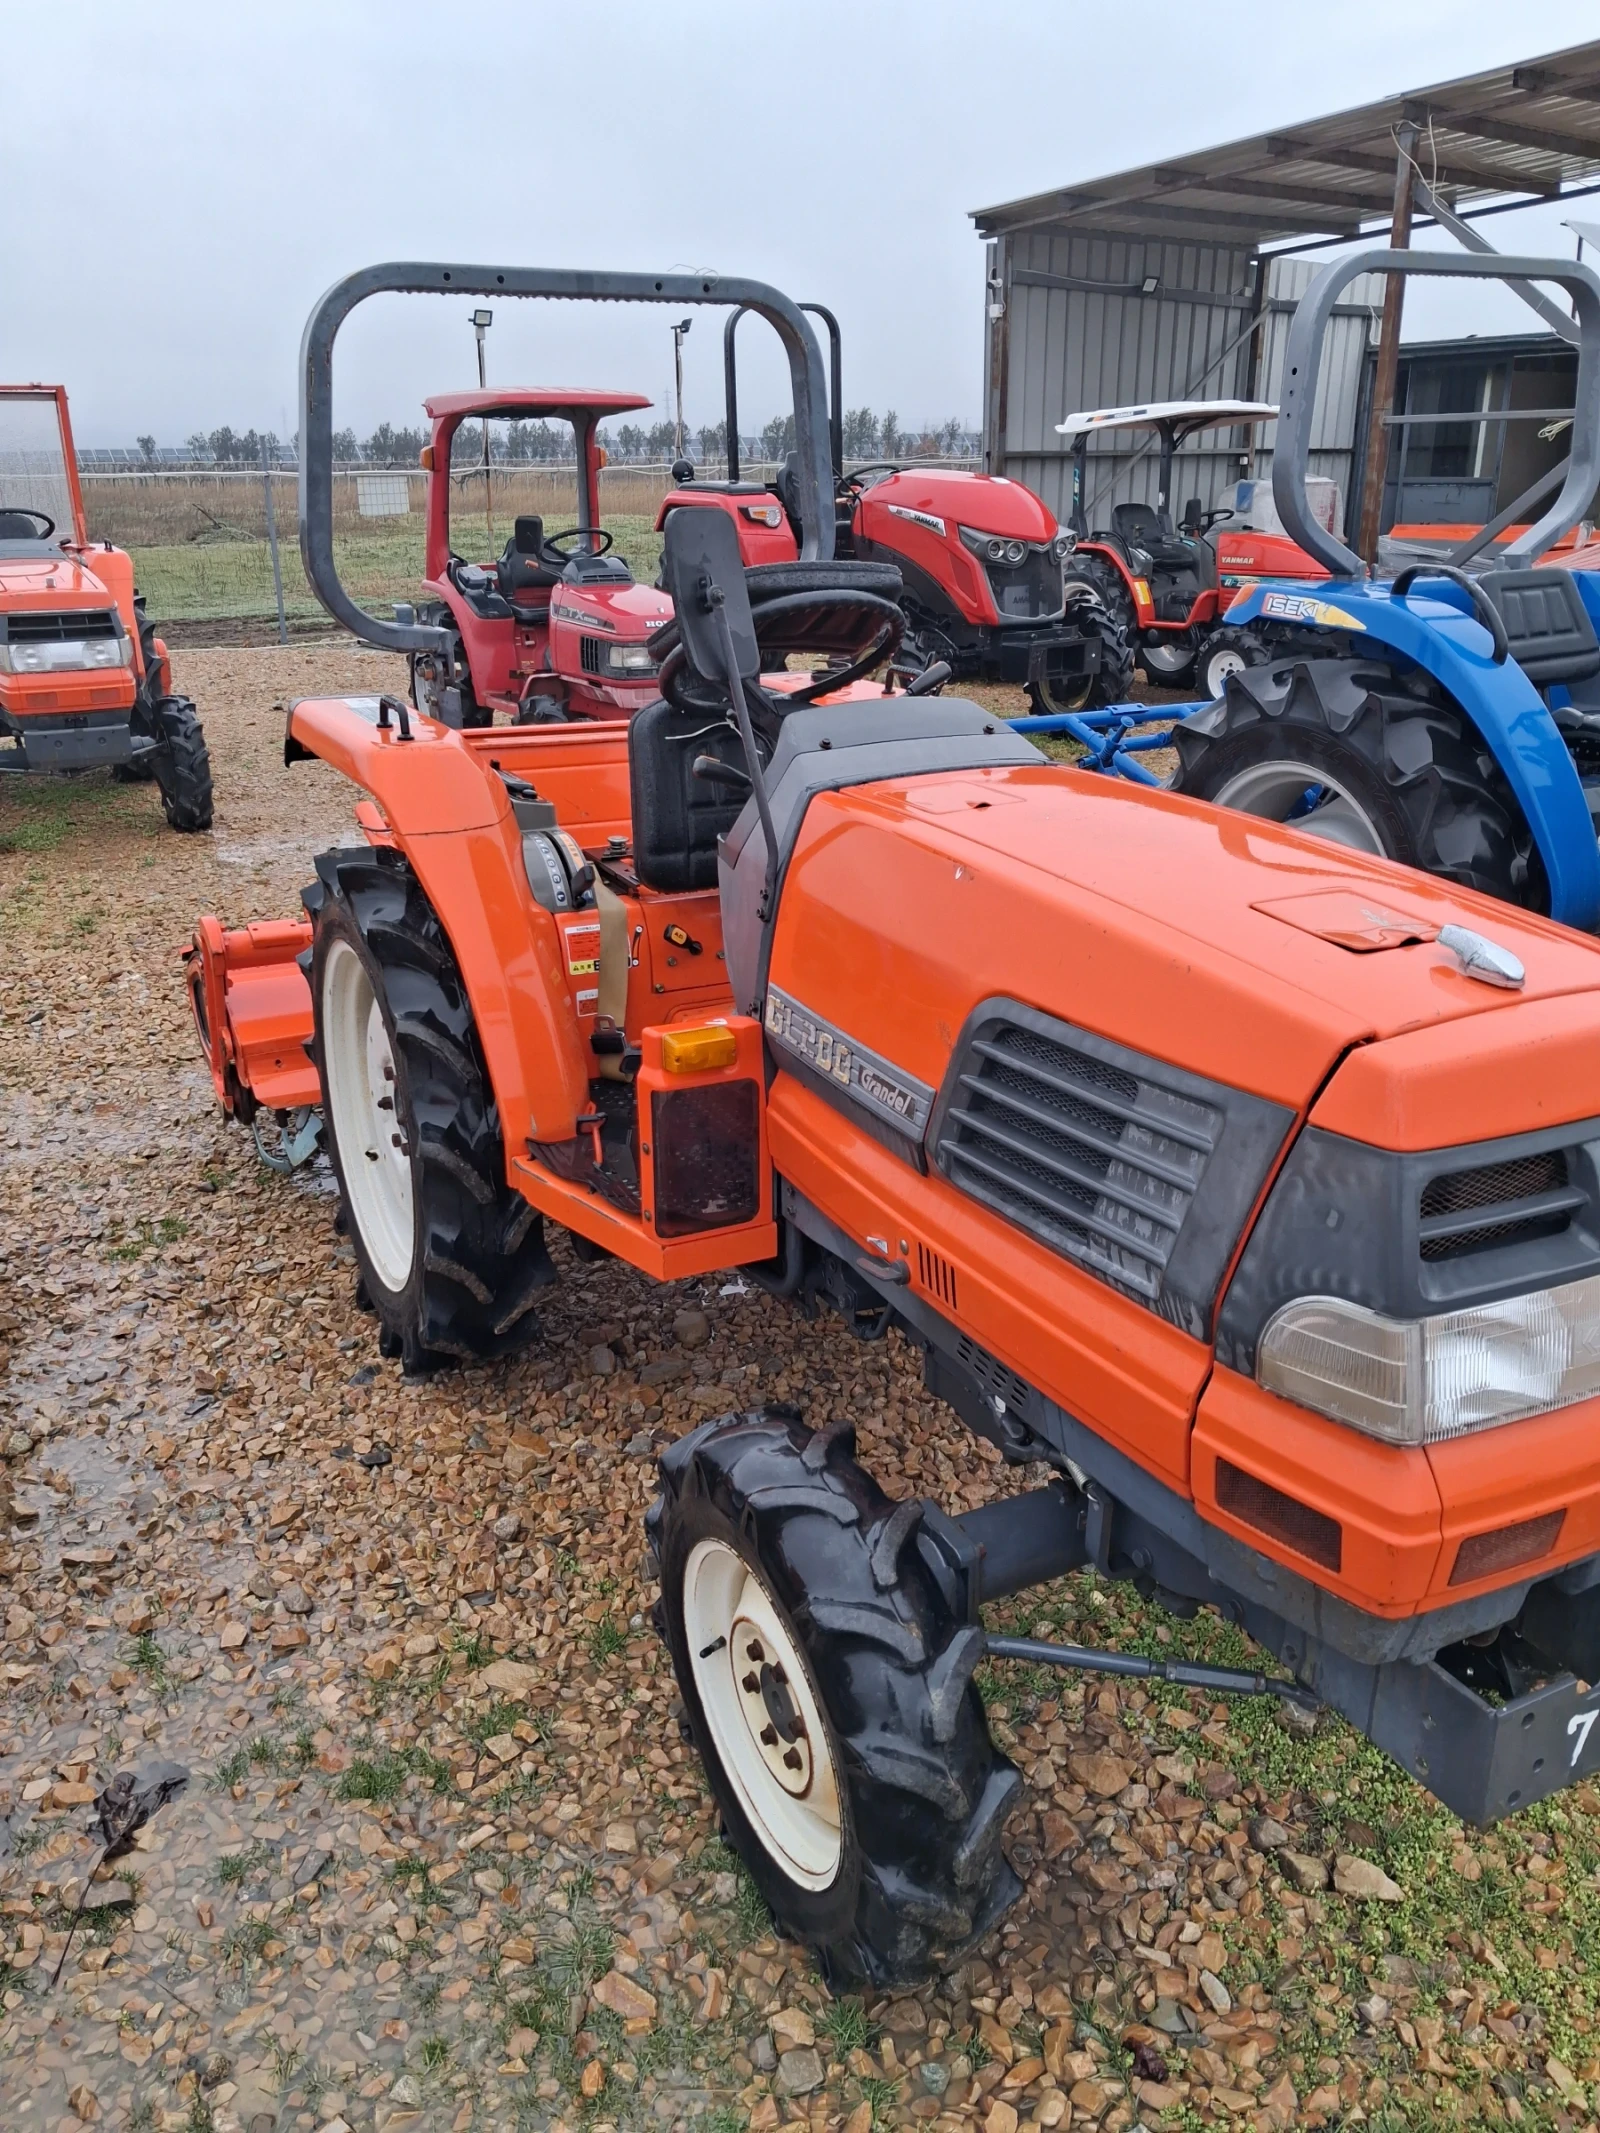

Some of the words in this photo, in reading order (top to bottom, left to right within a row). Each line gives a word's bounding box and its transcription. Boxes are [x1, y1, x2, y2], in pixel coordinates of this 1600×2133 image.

[1221, 556, 1254, 565] YANMAR
[1266, 596, 1318, 617] ISEKI
[861, 1069, 912, 1114] Grandel
[1567, 1709, 1600, 1767] 7
